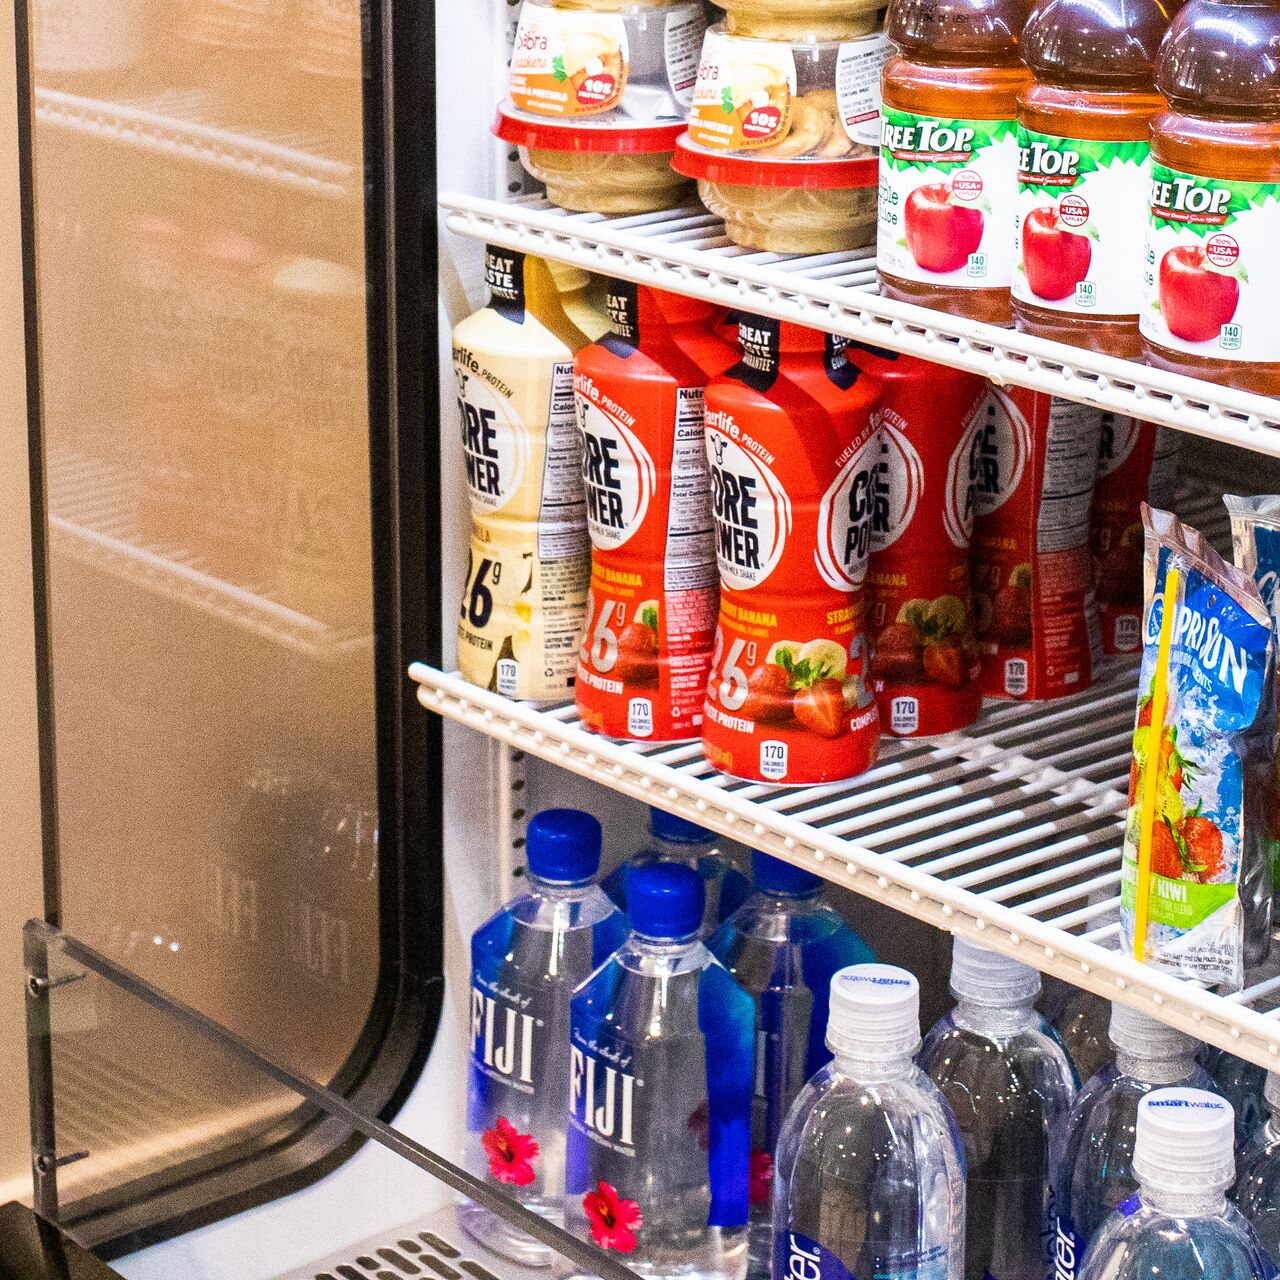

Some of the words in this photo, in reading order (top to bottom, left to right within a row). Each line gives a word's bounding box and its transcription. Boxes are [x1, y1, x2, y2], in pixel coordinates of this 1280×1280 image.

[584, 78, 613, 93] 10g
[749, 111, 777, 127] 10g
[919, 121, 975, 151] TOP
[1030, 142, 1080, 175] TOP
[958, 181, 977, 190] USA
[1172, 178, 1232, 213] TOP
[1065, 207, 1083, 215] USA
[1213, 247, 1232, 255] USA
[1079, 284, 1092, 294] 140
[1224, 327, 1238, 337] 140
[481, 369, 513, 399] PROTEIN
[601, 396, 635, 426] PROTEIN
[741, 434, 775, 465] PROTEIN
[738, 607, 777, 627] BANANA
[500, 664, 516, 676] 170
[588, 672, 623, 694] PROTEIN
[632, 703, 648, 716] 170
[895, 701, 915, 714] 170
[719, 711, 755, 733] PROTEIN
[764, 746, 784, 758] 170
[1157, 881, 1188, 905] KIWI
[840, 973, 911, 988] smartwater
[471, 987, 534, 1083] FIJI
[570, 1044, 635, 1145] FIJI
[1147, 1098, 1224, 1110] smartwater
